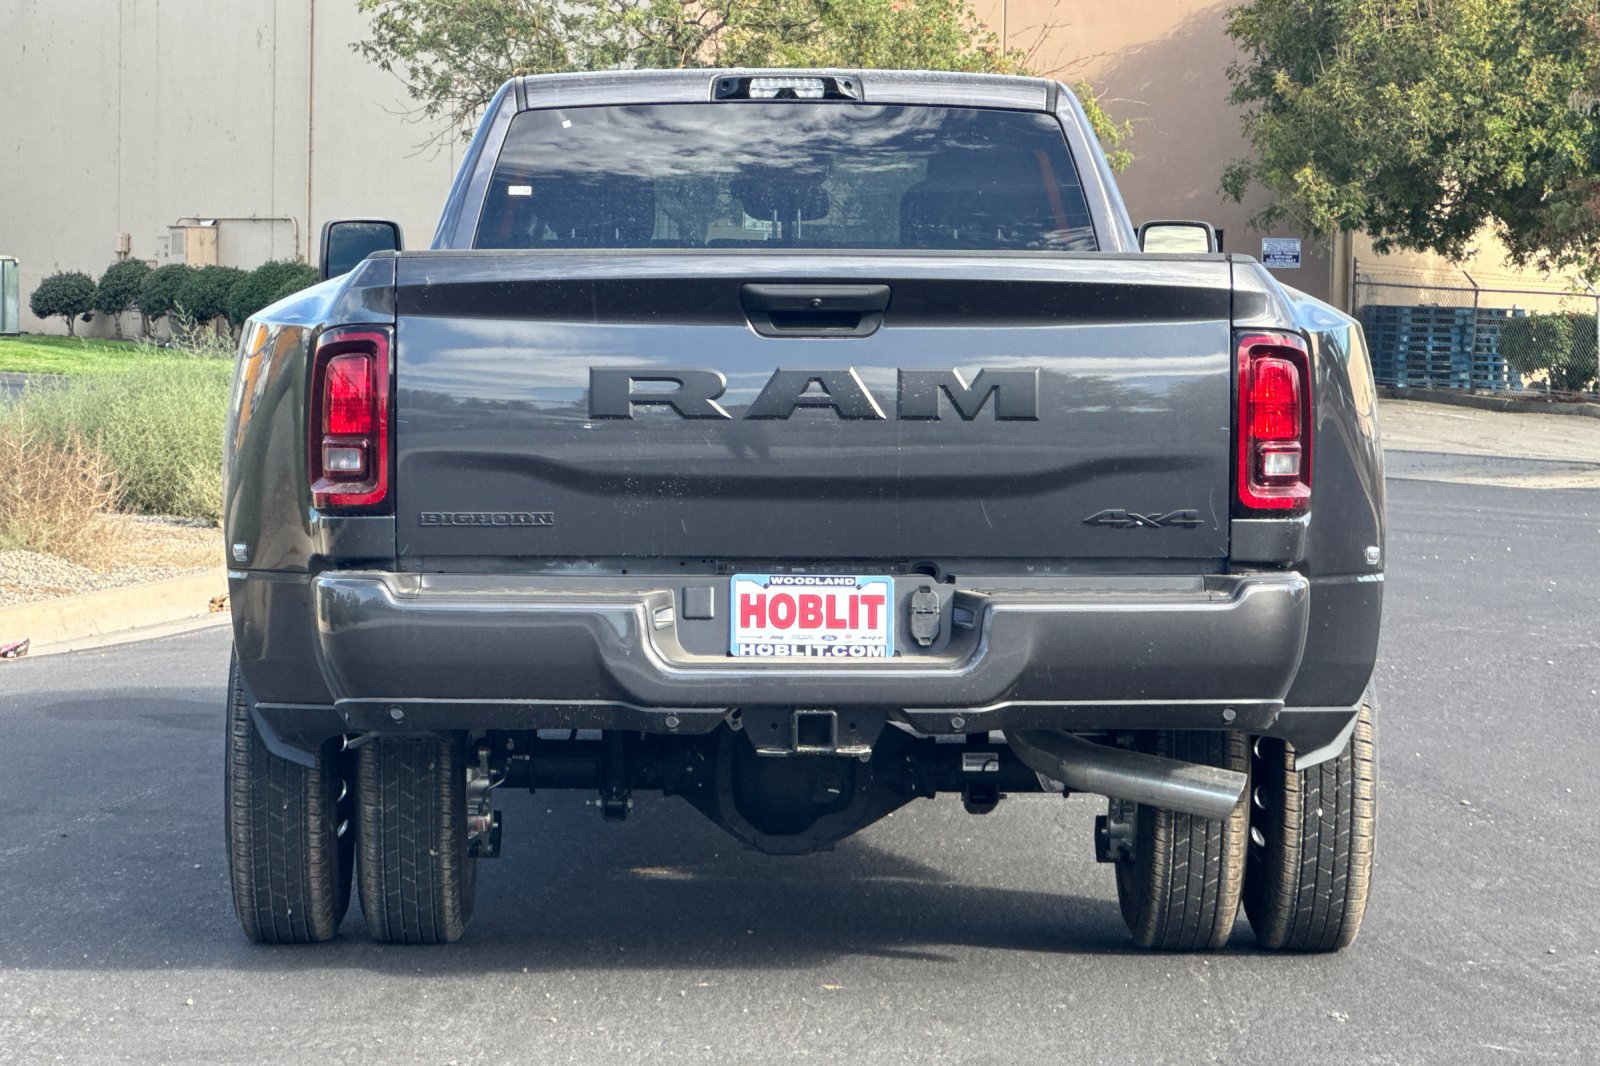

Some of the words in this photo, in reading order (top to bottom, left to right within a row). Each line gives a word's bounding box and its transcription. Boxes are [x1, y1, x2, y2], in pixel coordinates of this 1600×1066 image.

[589, 366, 1040, 421] RAM
[420, 511, 554, 526] BIGHORN
[769, 576, 856, 587] WOODLAND
[740, 592, 885, 630] HOBLIT
[739, 643, 886, 658] HOBLIT.COM
